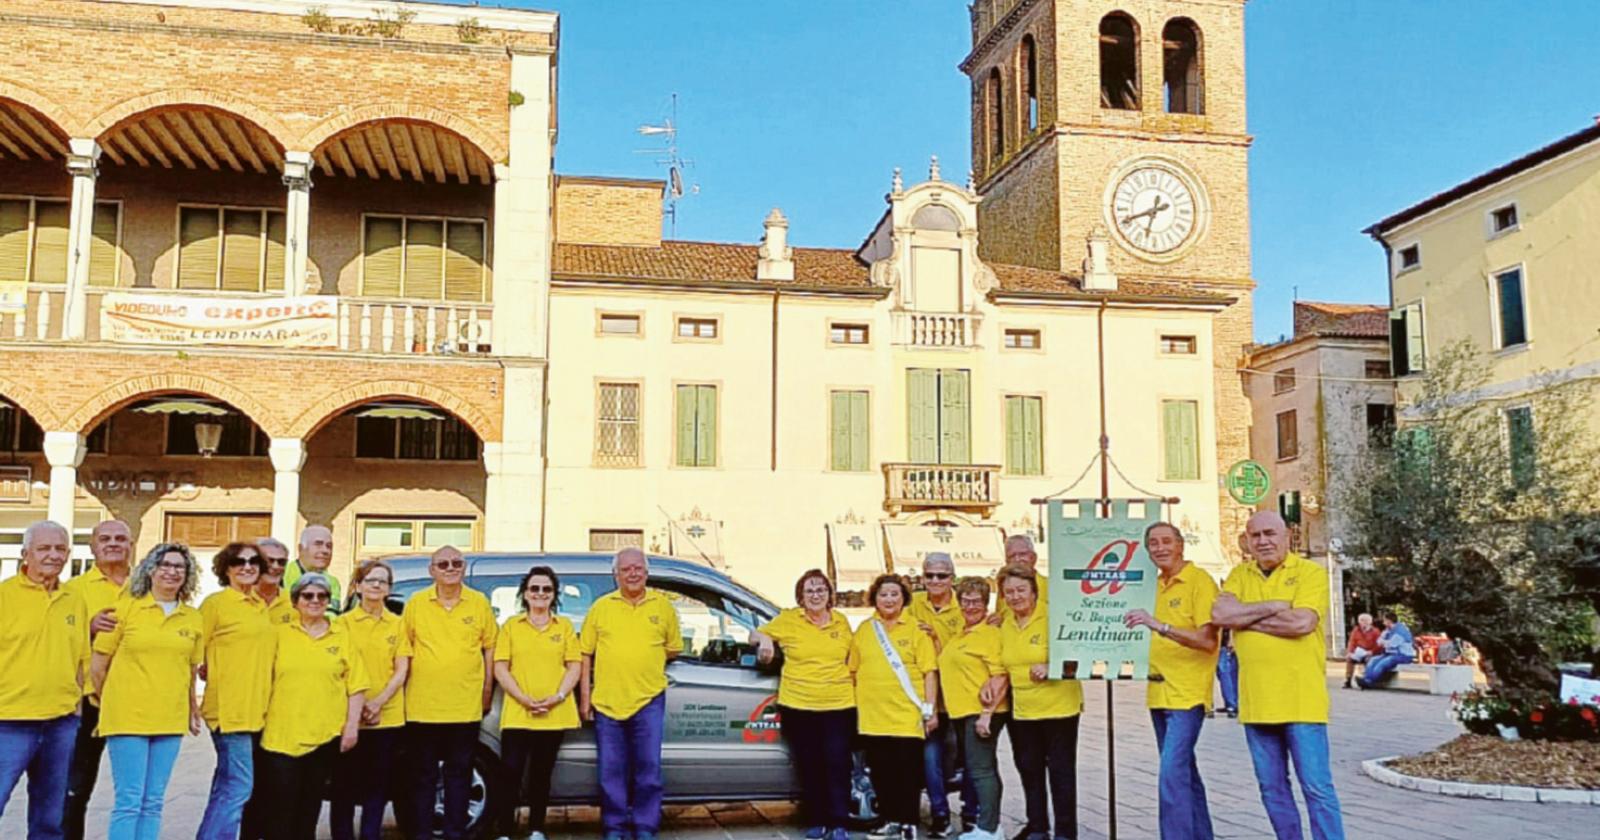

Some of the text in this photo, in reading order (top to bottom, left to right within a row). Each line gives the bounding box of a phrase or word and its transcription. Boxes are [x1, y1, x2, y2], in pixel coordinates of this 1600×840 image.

[190, 328, 301, 341] LENDINARA
[916, 551, 983, 559] FACIA
[1080, 597, 1127, 609] Sezione
[1089, 611, 1123, 625] Bagat
[1057, 624, 1144, 641] Lendinara
